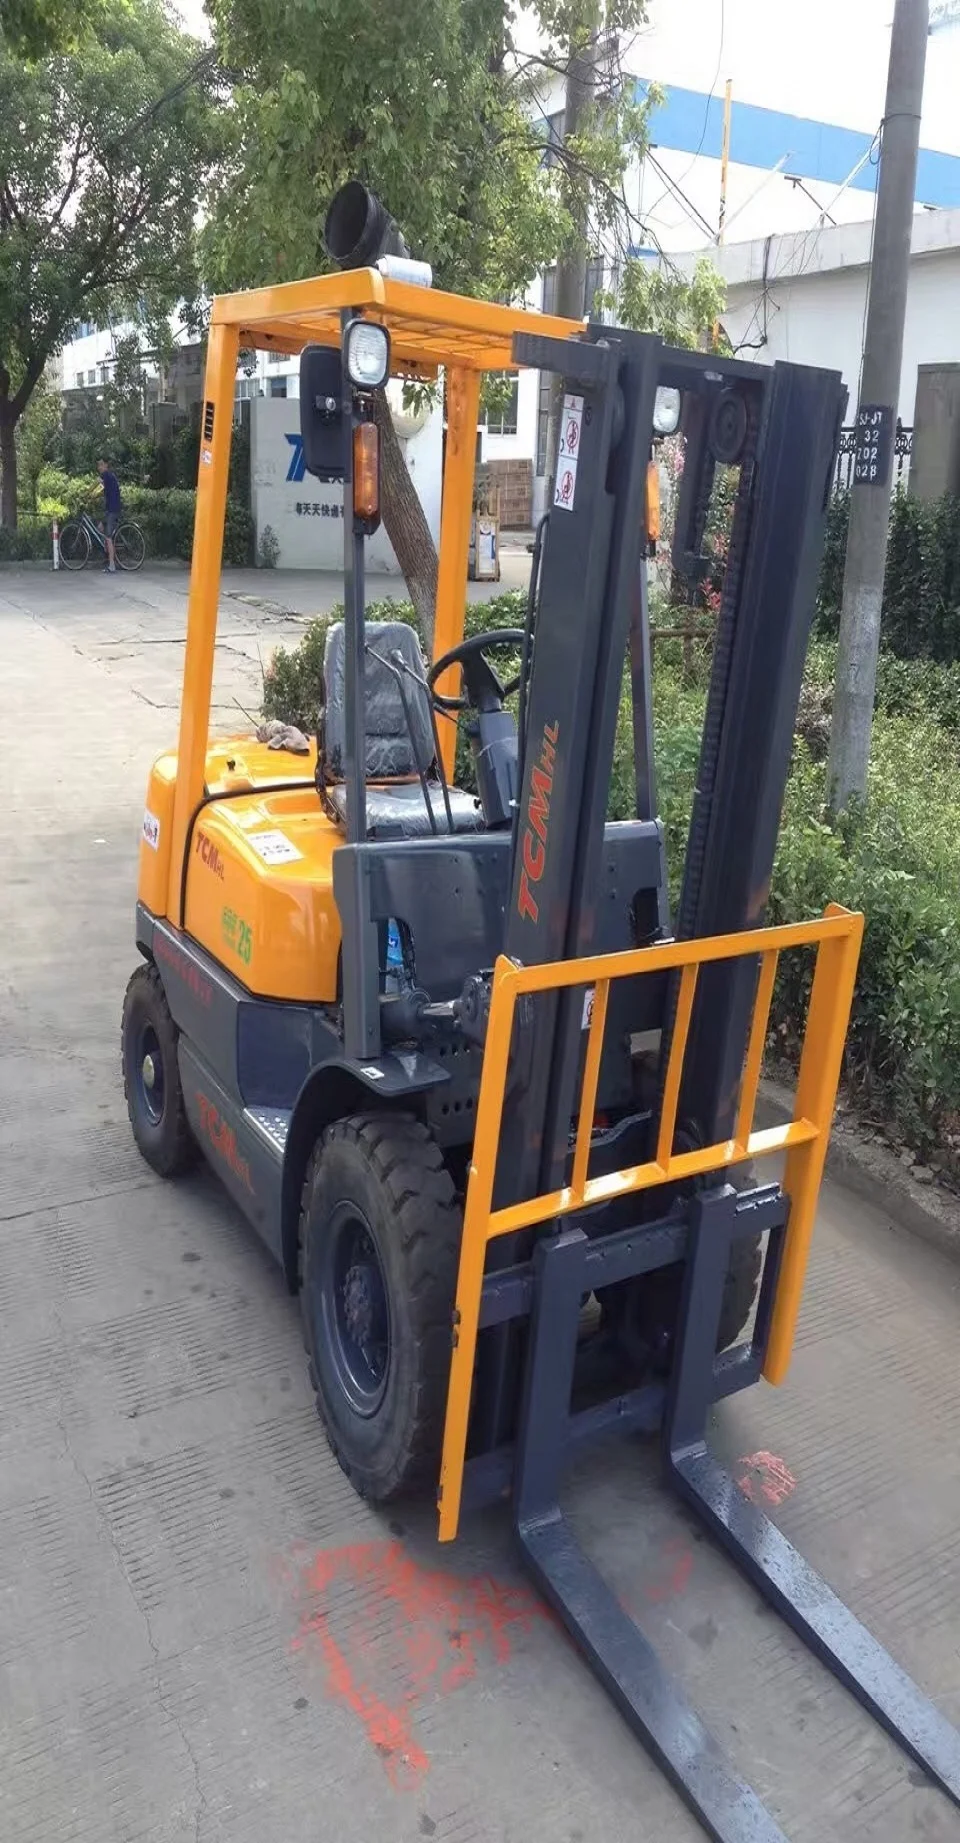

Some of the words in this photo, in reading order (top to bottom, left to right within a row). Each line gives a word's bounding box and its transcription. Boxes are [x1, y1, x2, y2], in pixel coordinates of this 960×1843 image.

[865, 430, 879, 441] 32
[856, 465, 877, 480] 028
[238, 919, 253, 965] 25
